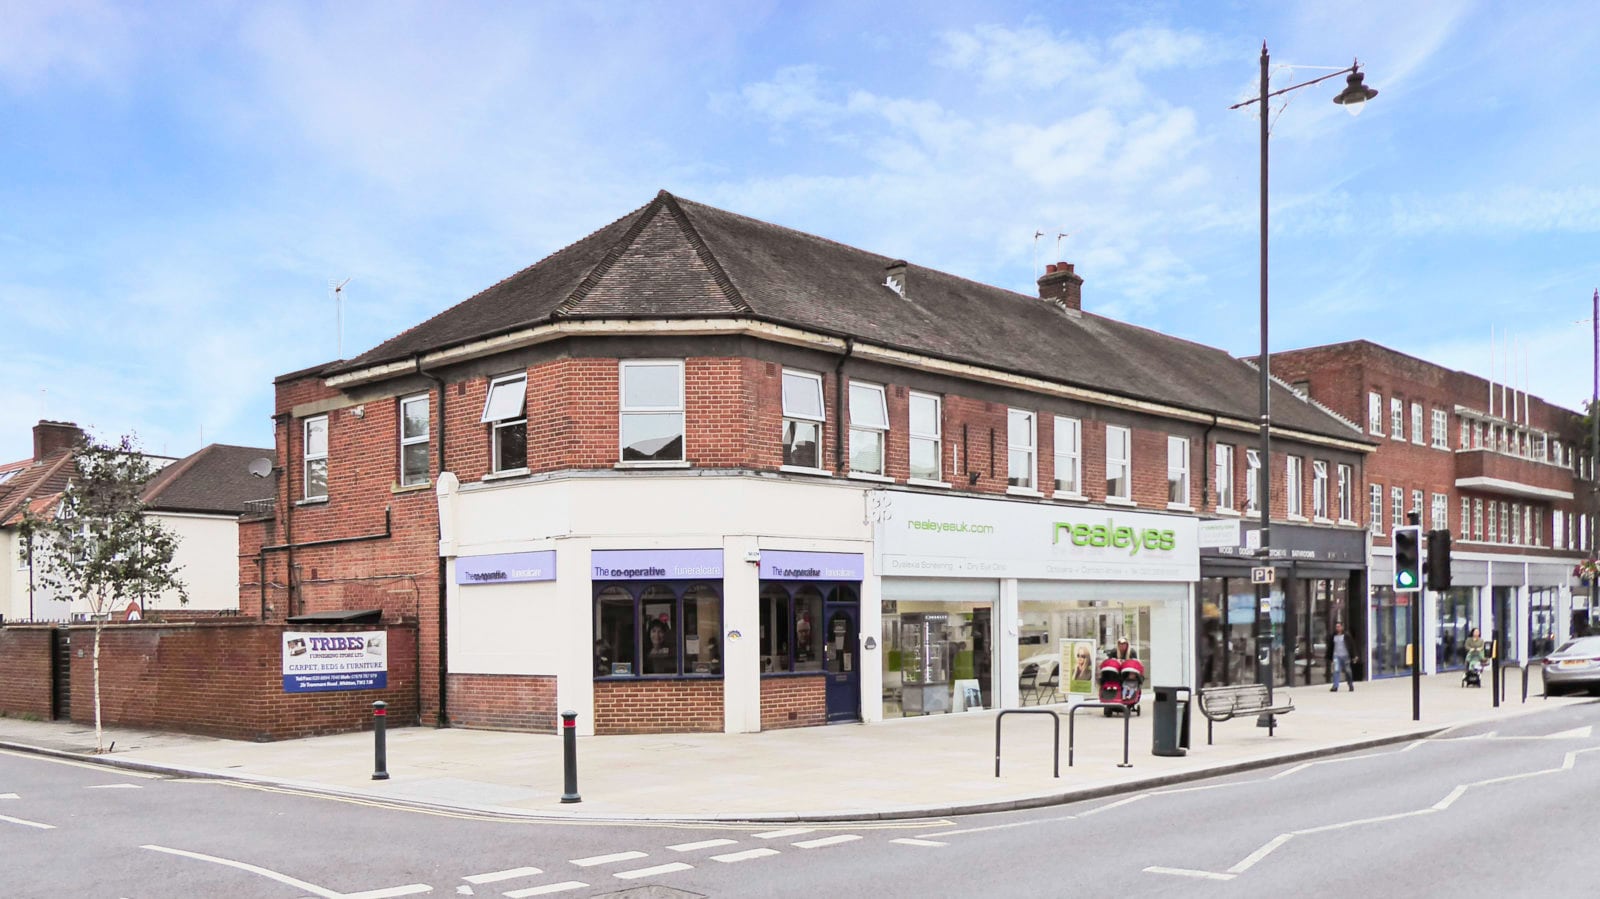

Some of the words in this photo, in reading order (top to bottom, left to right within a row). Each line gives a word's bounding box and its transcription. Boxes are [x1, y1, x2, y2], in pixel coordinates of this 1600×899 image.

[908, 518, 994, 534] realeyesuk.com
[1052, 518, 1175, 557] realeyes
[465, 571, 474, 581] The
[473, 570, 508, 582] co-operative
[594, 566, 609, 577] The
[610, 566, 666, 578] co-operative
[674, 565, 721, 576] funeralcare
[772, 566, 782, 576] The
[783, 567, 821, 578] co-operative
[309, 637, 365, 651] TRIBES
[321, 663, 338, 671] BEDS
[347, 661, 383, 670] FURNITURE
